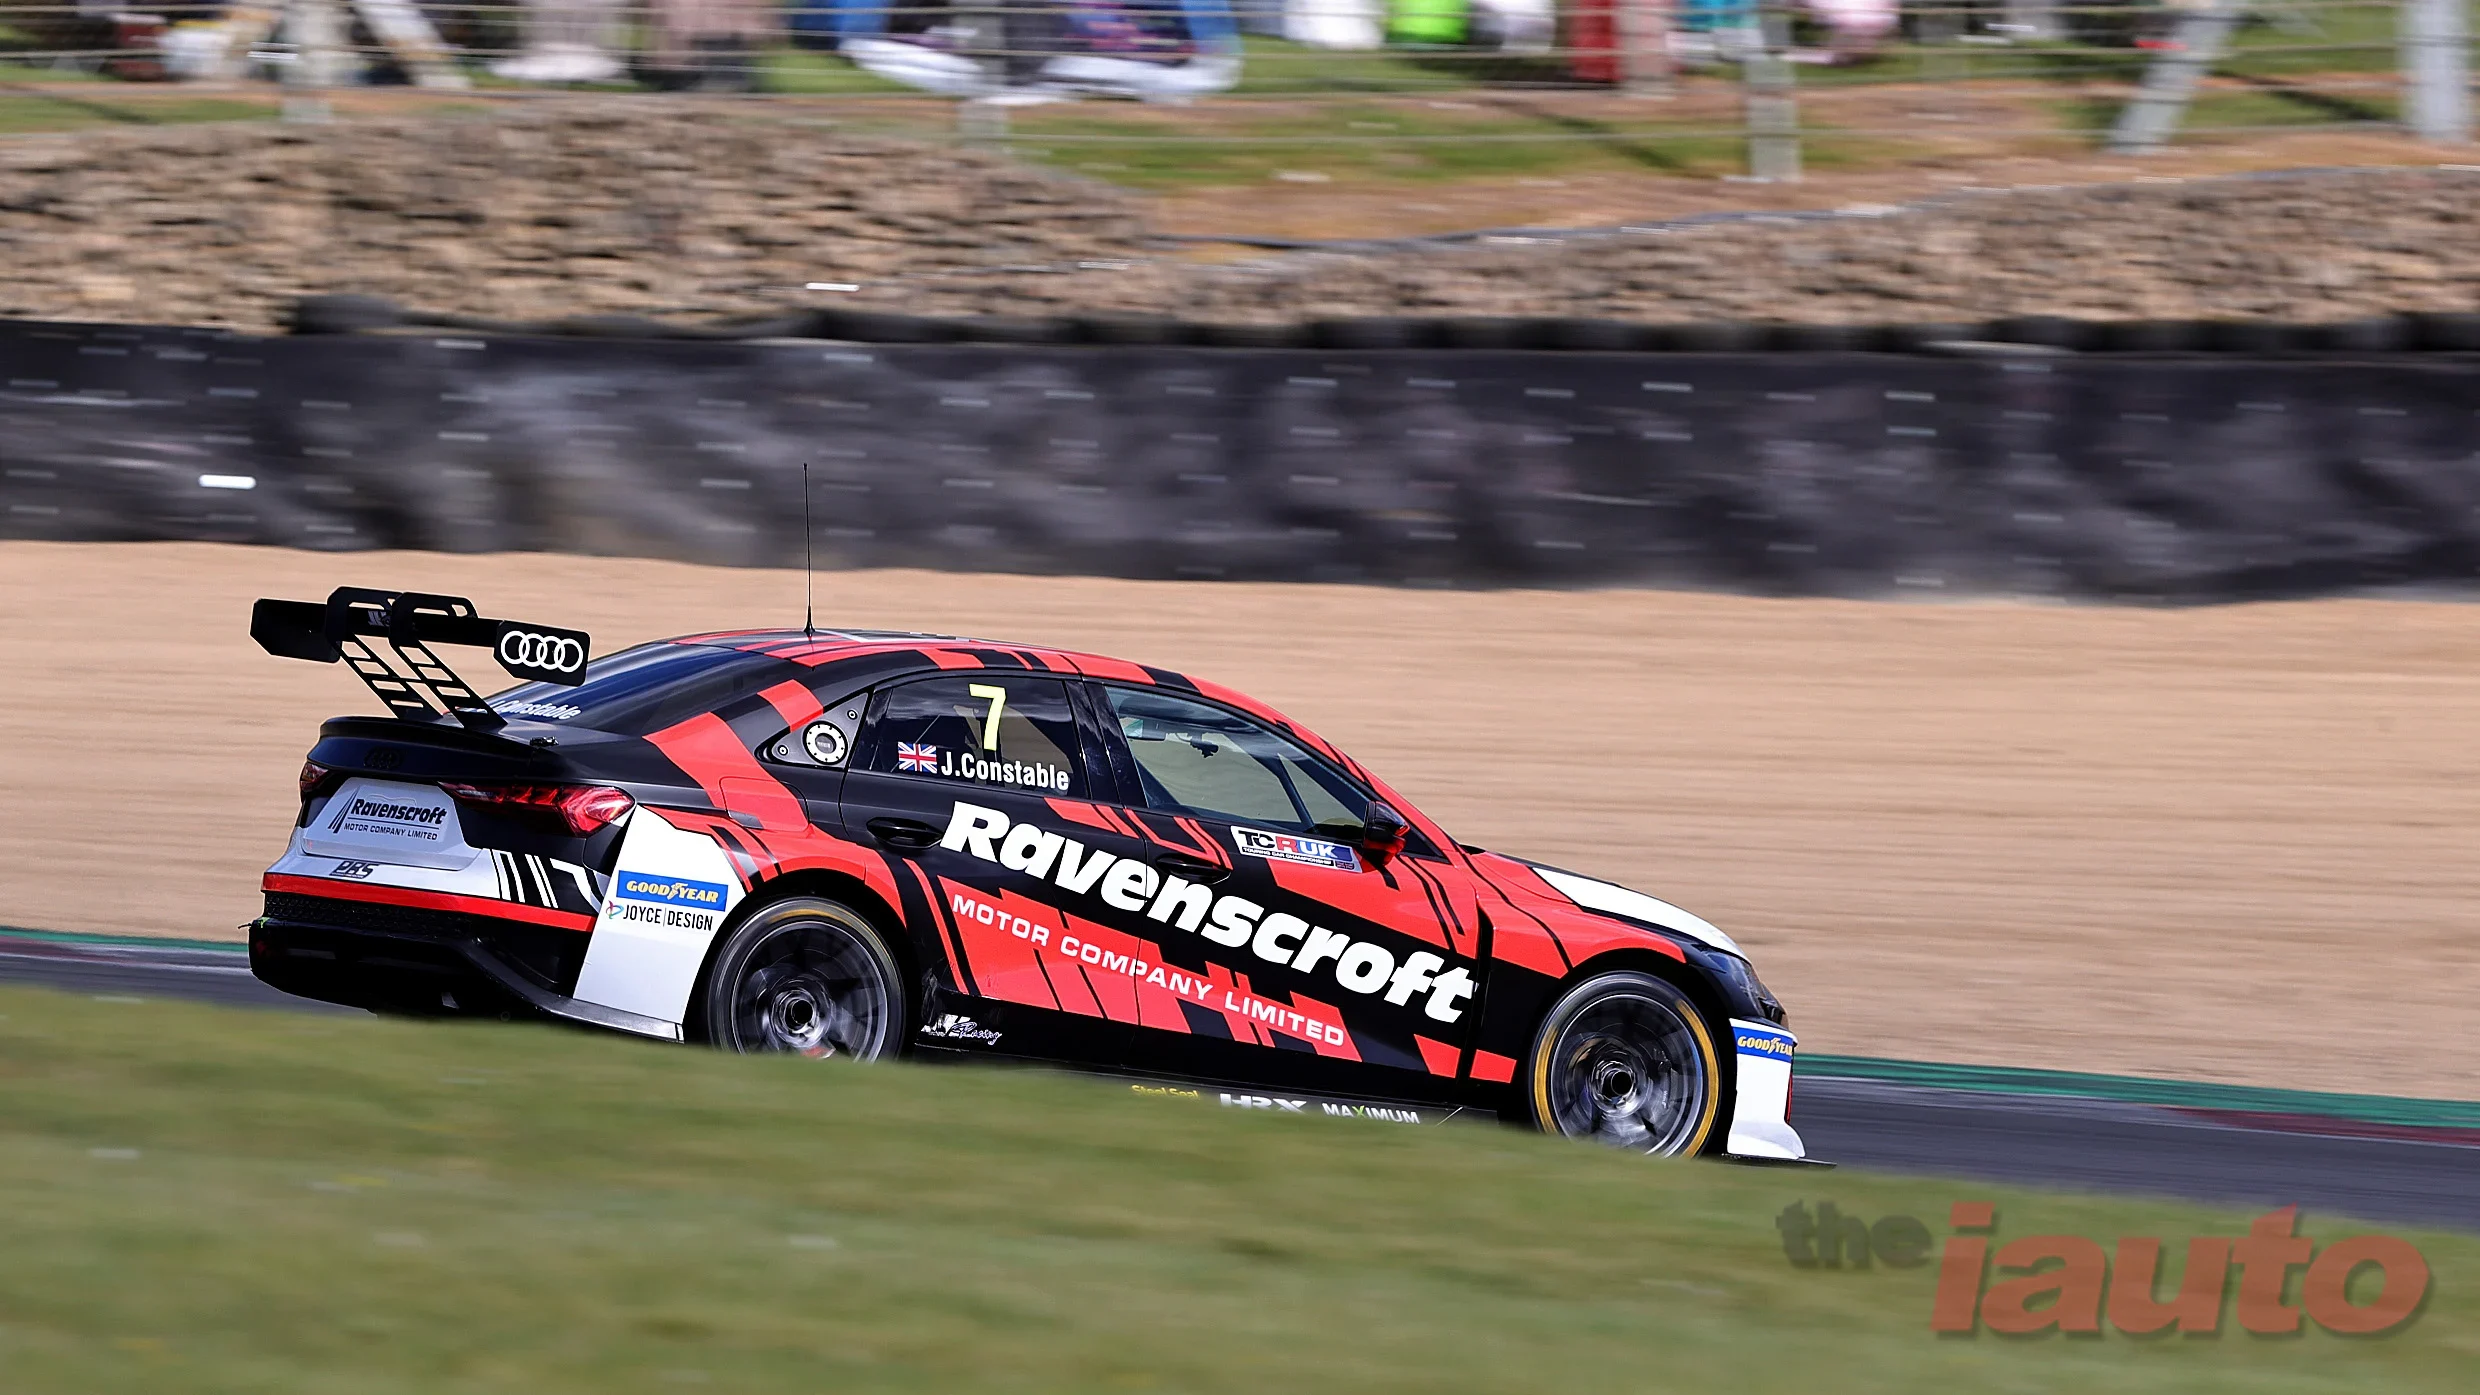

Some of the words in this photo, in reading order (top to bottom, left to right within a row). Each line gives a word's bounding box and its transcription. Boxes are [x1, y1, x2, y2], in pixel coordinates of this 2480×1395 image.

[969, 683, 1006, 751] 7
[941, 751, 1069, 791] J.Constable
[351, 798, 447, 825] Ravenscroft
[344, 822, 368, 833] MOTOR
[370, 825, 406, 836] COMPANY
[407, 829, 438, 841] LIMITED
[626, 880, 719, 903] GOODYEAR
[623, 904, 662, 924] JOYCE
[667, 910, 713, 931] DESIGN
[940, 801, 1479, 1023] Ravenscroft
[952, 894, 1050, 947] MOTOR
[1060, 935, 1213, 1001] COMPANY
[1225, 991, 1345, 1046] LIMITED
[1322, 1102, 1420, 1124] MAXIMUM
